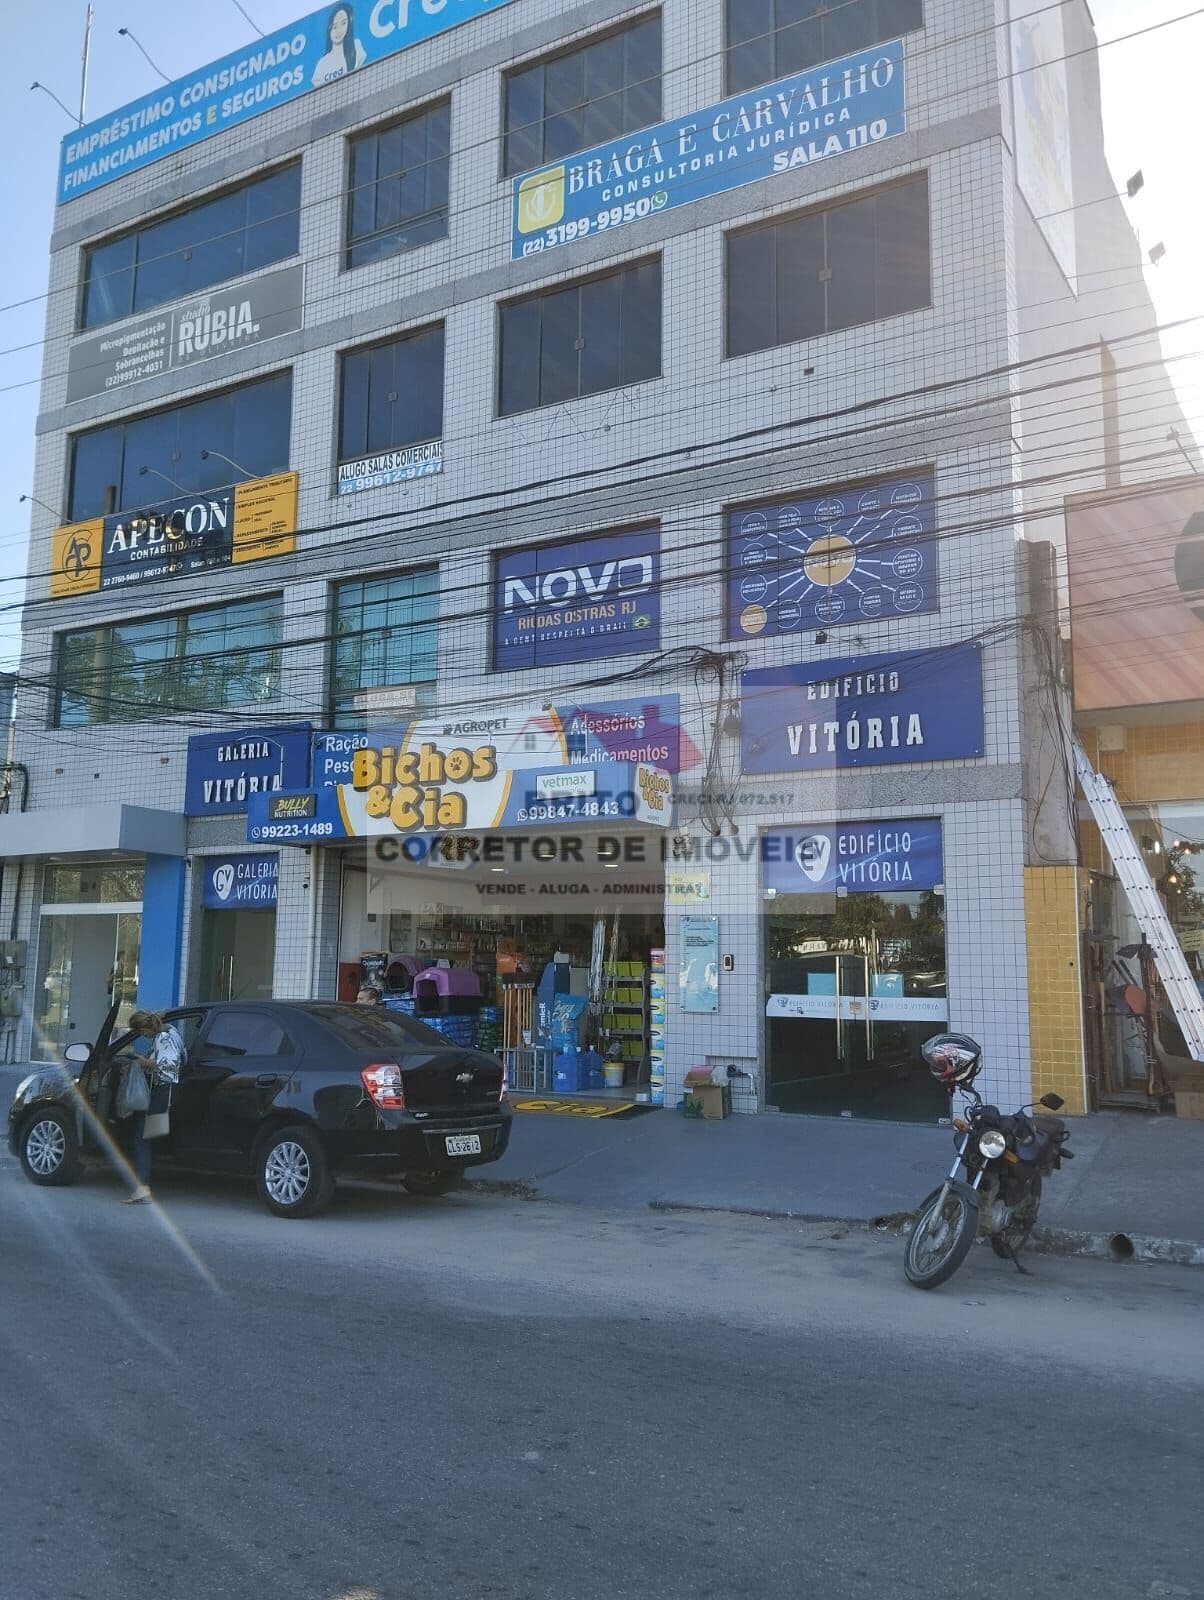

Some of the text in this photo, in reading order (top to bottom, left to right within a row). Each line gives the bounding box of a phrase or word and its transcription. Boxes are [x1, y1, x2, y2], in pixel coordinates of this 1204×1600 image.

[66, 34, 306, 164] EMPRÉSTIMO CONSIGNADO
[64, 65, 304, 192] FINANCIAMENTOS E SEGUROS
[568, 57, 894, 195] BRAGA E CARVALHO
[602, 107, 850, 201] CONSULTORIA JURÍDICA
[773, 118, 888, 171] SALA 110
[522, 197, 650, 256] (22) 3199-9950
[99, 321, 166, 352] Micropigmentação
[115, 348, 164, 372] Sobrancelhas
[340, 442, 442, 480] ALUGO SALAS COMERCIAIS
[107, 497, 230, 554] APECON
[130, 536, 205, 560] CONTABILIDADE
[504, 555, 653, 614] NOVO
[537, 613, 561, 629] DAS
[564, 604, 616, 624] OSTRAS
[621, 600, 637, 616] RJ
[454, 718, 509, 733] AGROPET
[787, 711, 923, 755] VITÓRIA
[217, 742, 269, 762] GALERIA
[326, 734, 368, 755] Ração
[571, 744, 668, 765] Medicamentos
[325, 759, 354, 774] Pes
[352, 742, 496, 790] Bichos
[204, 771, 281, 803] VITÓRIA
[542, 774, 587, 788] vetmax
[639, 767, 670, 794] Bichos
[274, 808, 308, 818] NUTRITION
[276, 796, 310, 812] BULLY
[529, 801, 619, 820] 99847-4843
[262, 823, 333, 838] 99223-1489
[838, 829, 911, 855] EDIFÍCIO
[237, 862, 279, 878] GALERIA
[839, 857, 912, 882] VITÓRIA
